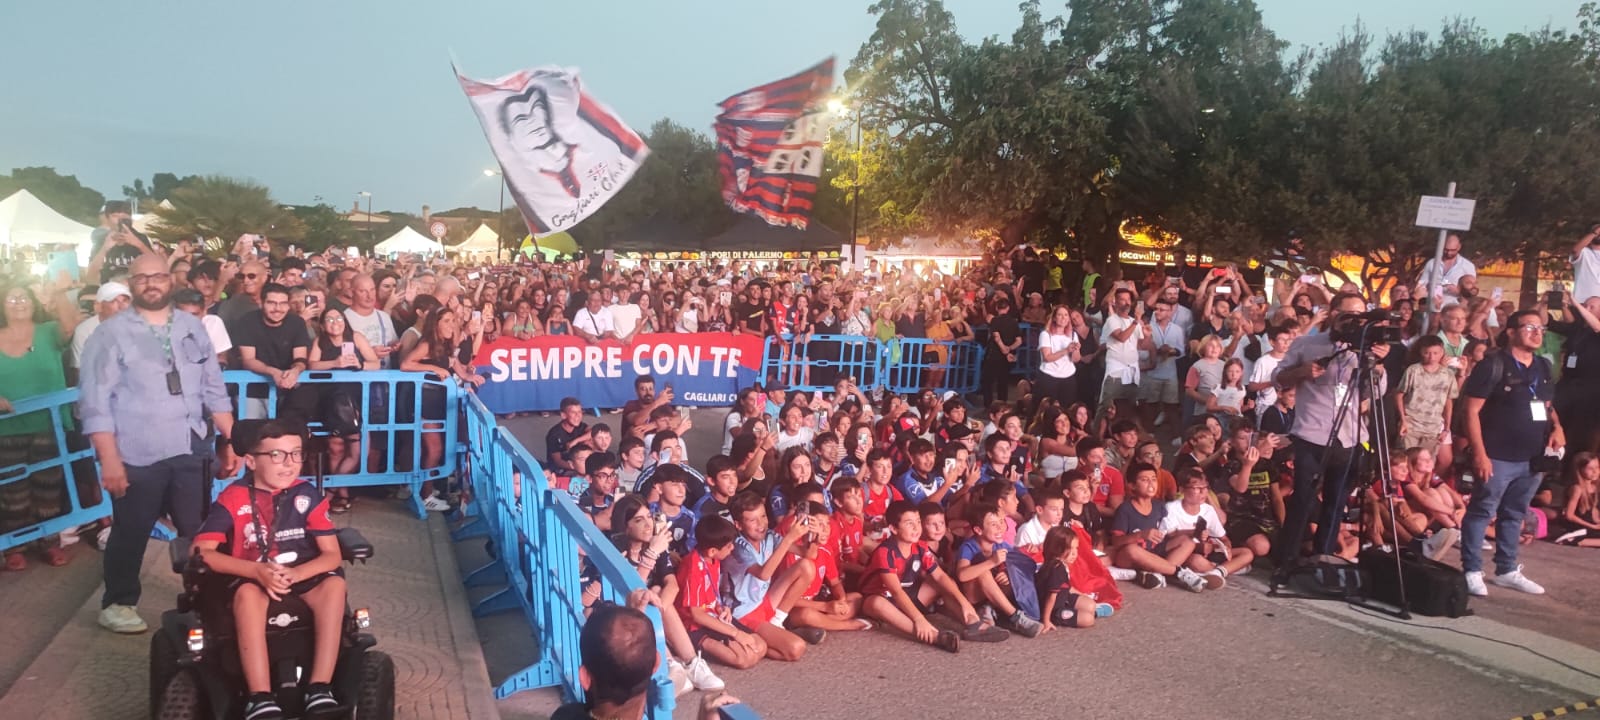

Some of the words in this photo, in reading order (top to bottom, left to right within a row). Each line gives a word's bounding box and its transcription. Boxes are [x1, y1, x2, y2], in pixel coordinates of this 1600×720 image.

[700, 250, 731, 259] SPORI
[733, 250, 742, 259] DI
[743, 250, 783, 259] PALERMO
[490, 347, 623, 383] SEMPRE
[632, 343, 700, 377] CON
[710, 346, 742, 379] TE
[684, 391, 727, 402] CAGLIARI
